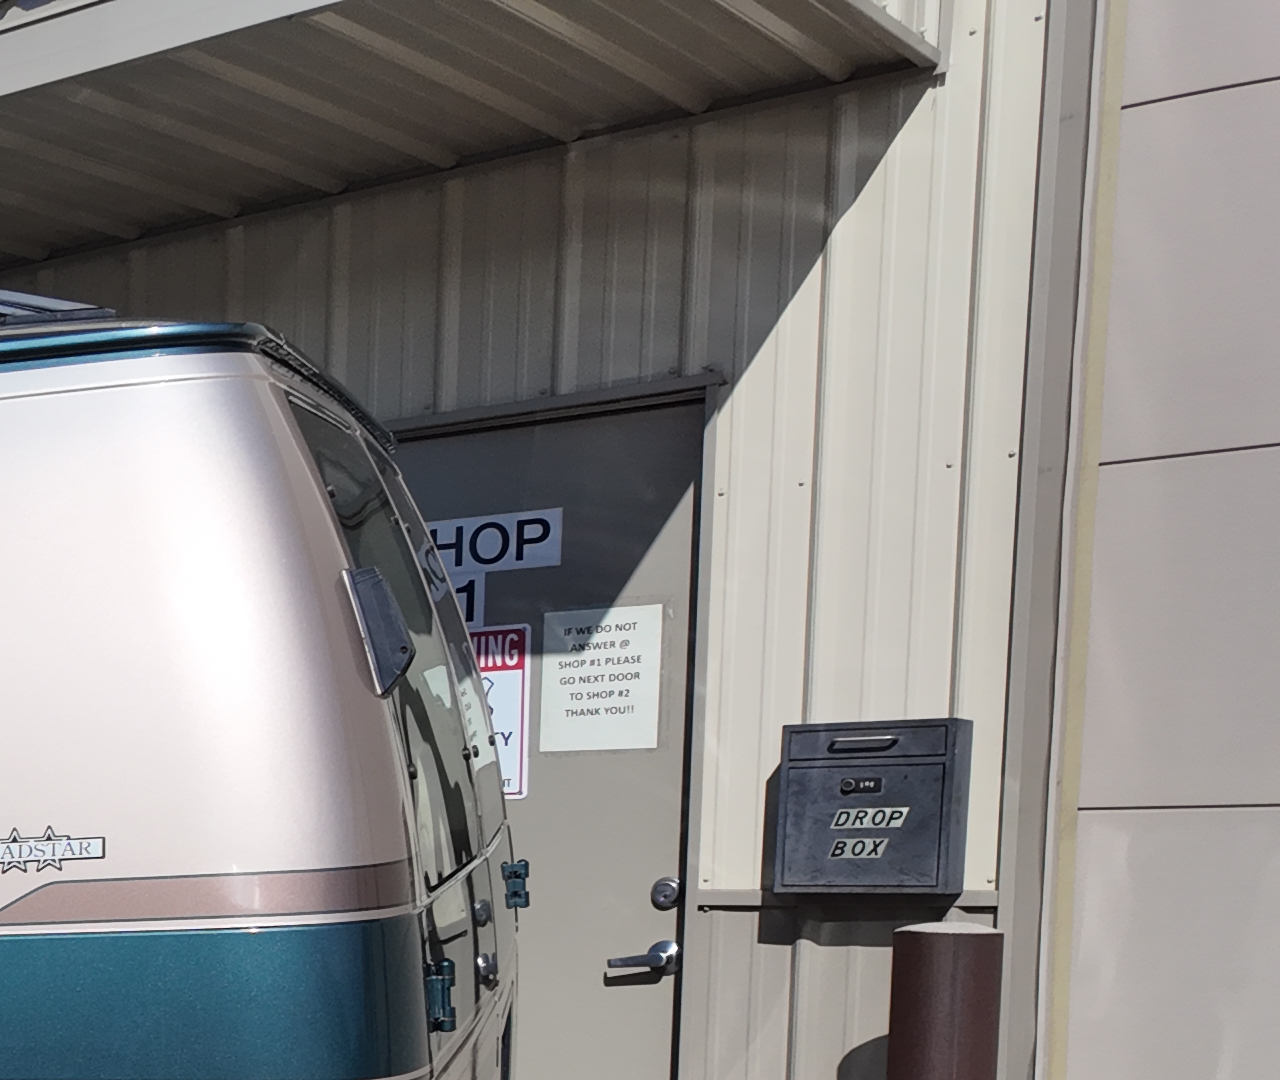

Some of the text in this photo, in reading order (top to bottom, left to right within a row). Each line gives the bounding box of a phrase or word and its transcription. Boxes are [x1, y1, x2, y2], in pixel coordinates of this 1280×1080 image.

[430, 517, 551, 567] HOP
[455, 579, 476, 623] 1
[564, 622, 638, 636] IF WE DO NOT
[570, 639, 630, 652] ANSWER @
[558, 654, 642, 670] SHOP #1 PLEASE
[559, 671, 641, 686] GO NEXT DOOR
[569, 688, 630, 701] TO SHOP #2
[565, 704, 634, 717] THANK YOU!!
[833, 809, 904, 827] DROP
[830, 839, 885, 857] BOX
